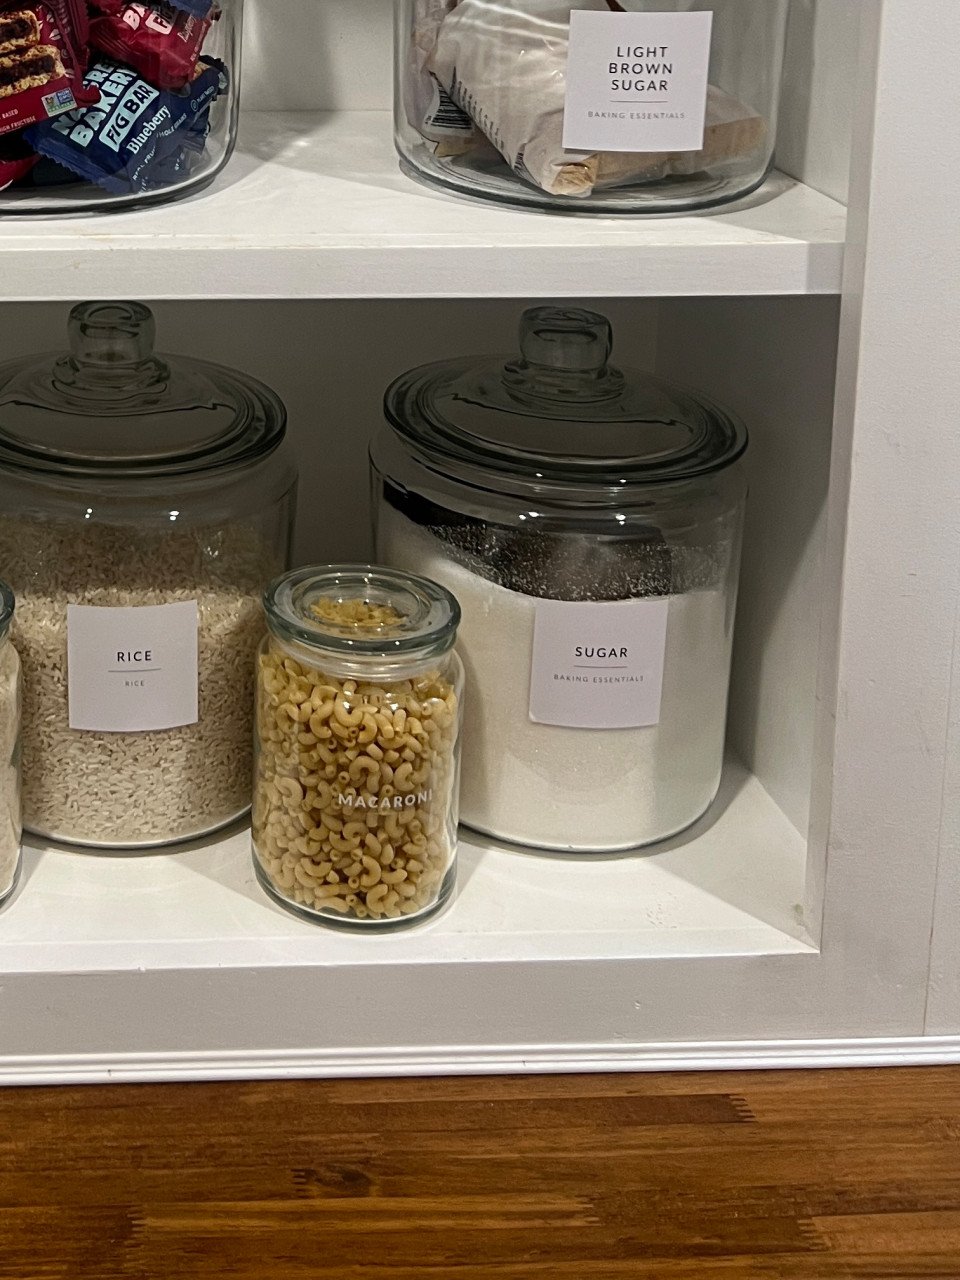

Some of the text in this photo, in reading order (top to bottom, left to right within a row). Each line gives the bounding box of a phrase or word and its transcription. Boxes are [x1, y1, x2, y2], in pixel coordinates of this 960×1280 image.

[616, 45, 669, 59] LIGHT
[608, 62, 673, 75] BROWN
[610, 79, 669, 92] SUGAR
[105, 81, 155, 146] FIG BAR
[587, 110, 686, 121] BAKING ESSENTIALS
[126, 104, 171, 155] Blueberry
[116, 650, 153, 663] RICE
[574, 645, 629, 659] SUGAR
[124, 679, 146, 688] RICE
[553, 673, 645, 684] BAKING ESSENTIALS
[338, 789, 433, 810] MACARONI
